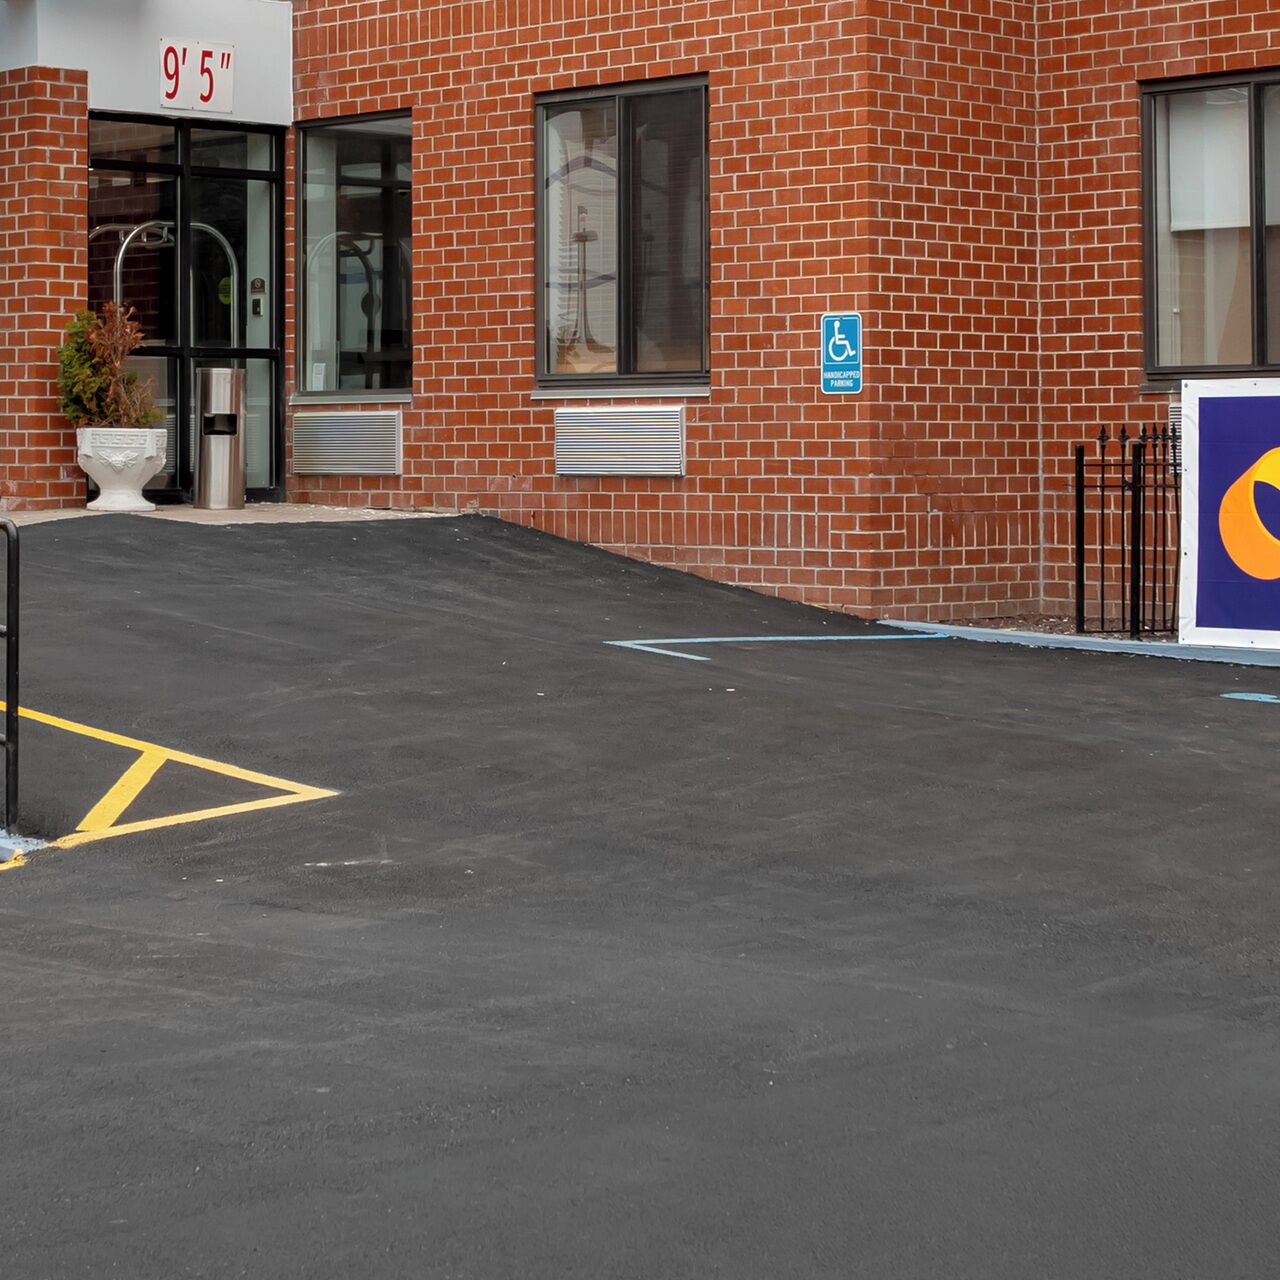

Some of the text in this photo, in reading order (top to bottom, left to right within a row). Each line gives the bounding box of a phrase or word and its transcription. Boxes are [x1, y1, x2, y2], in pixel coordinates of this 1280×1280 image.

[163, 46, 231, 103] 9' 5"
[823, 370, 860, 379] HANDICAPPED
[830, 379, 854, 387] PARKING
